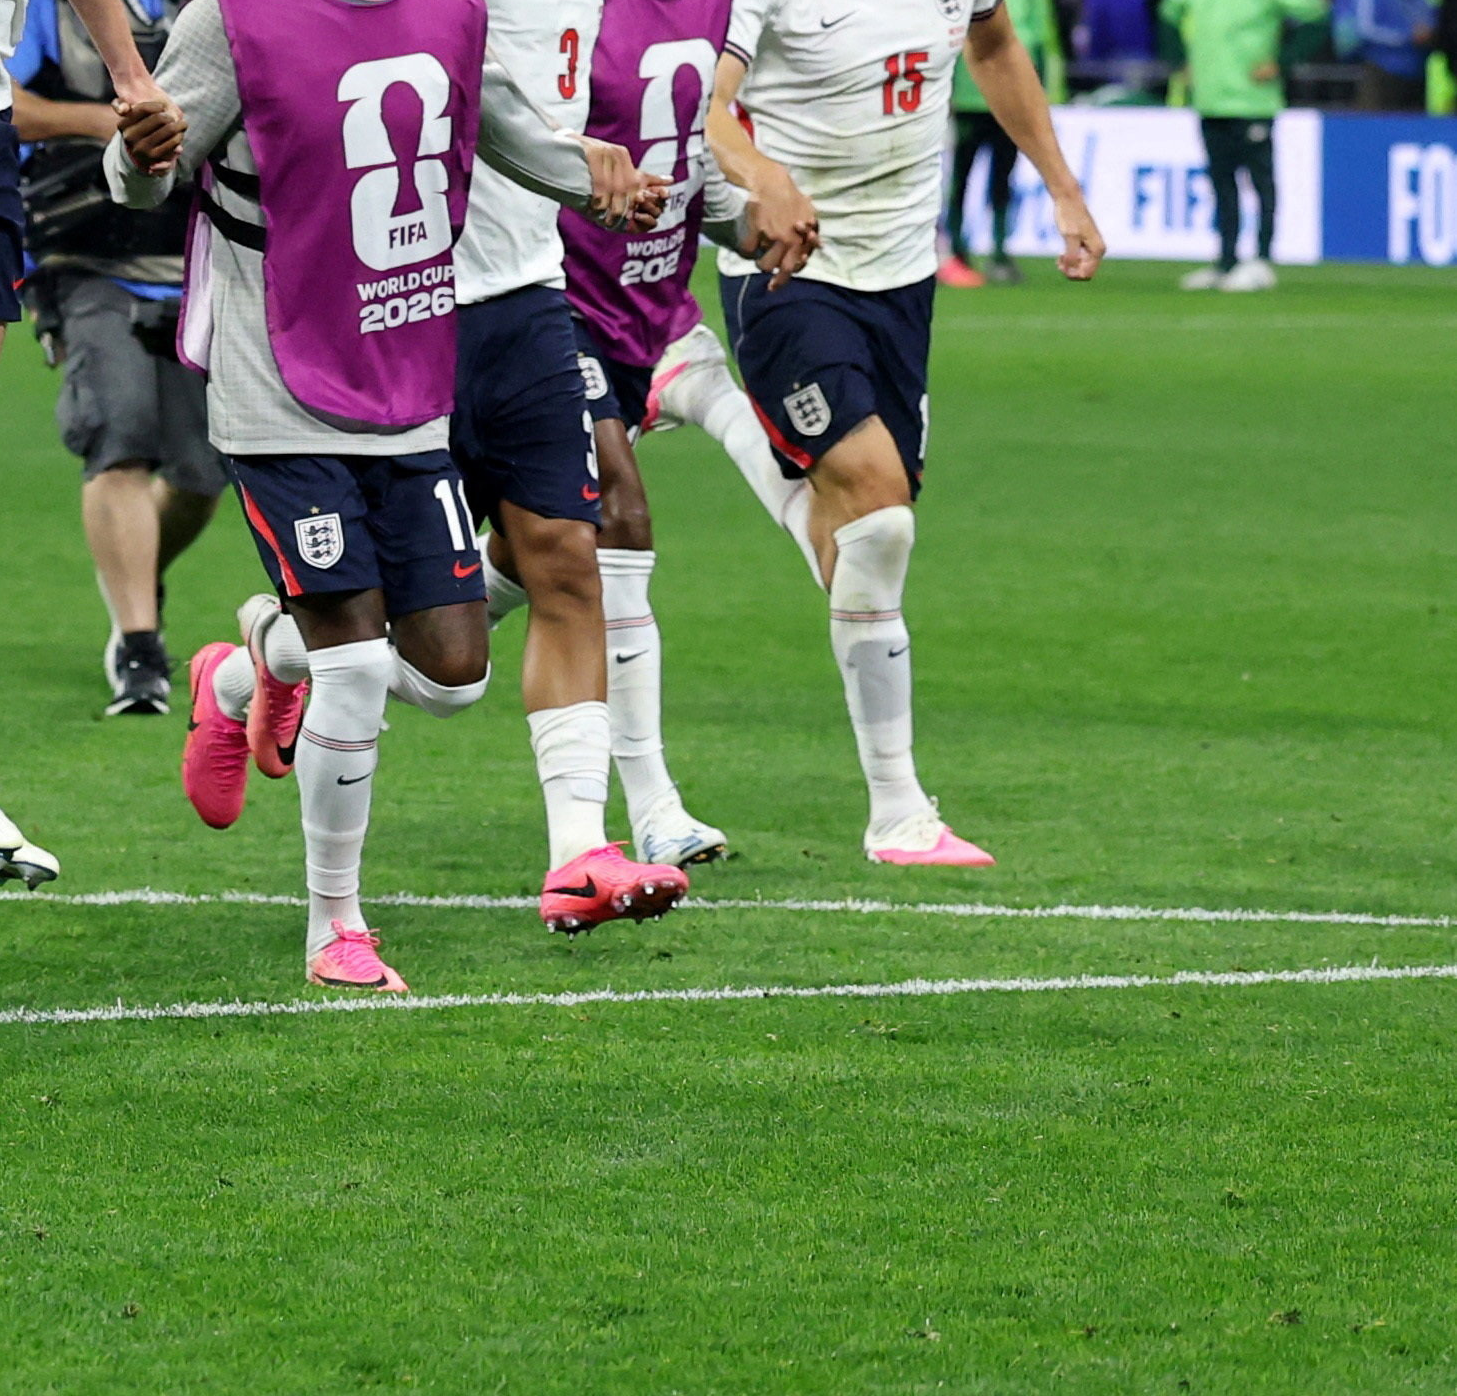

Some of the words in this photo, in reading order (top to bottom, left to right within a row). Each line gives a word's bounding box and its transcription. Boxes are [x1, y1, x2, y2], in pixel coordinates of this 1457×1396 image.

[557, 28, 579, 100] 3
[882, 51, 929, 116] 15
[388, 221, 428, 249] FIFA
[356, 272, 420, 302] WORLD
[422, 265, 455, 286] CUP
[359, 286, 455, 335] 2026
